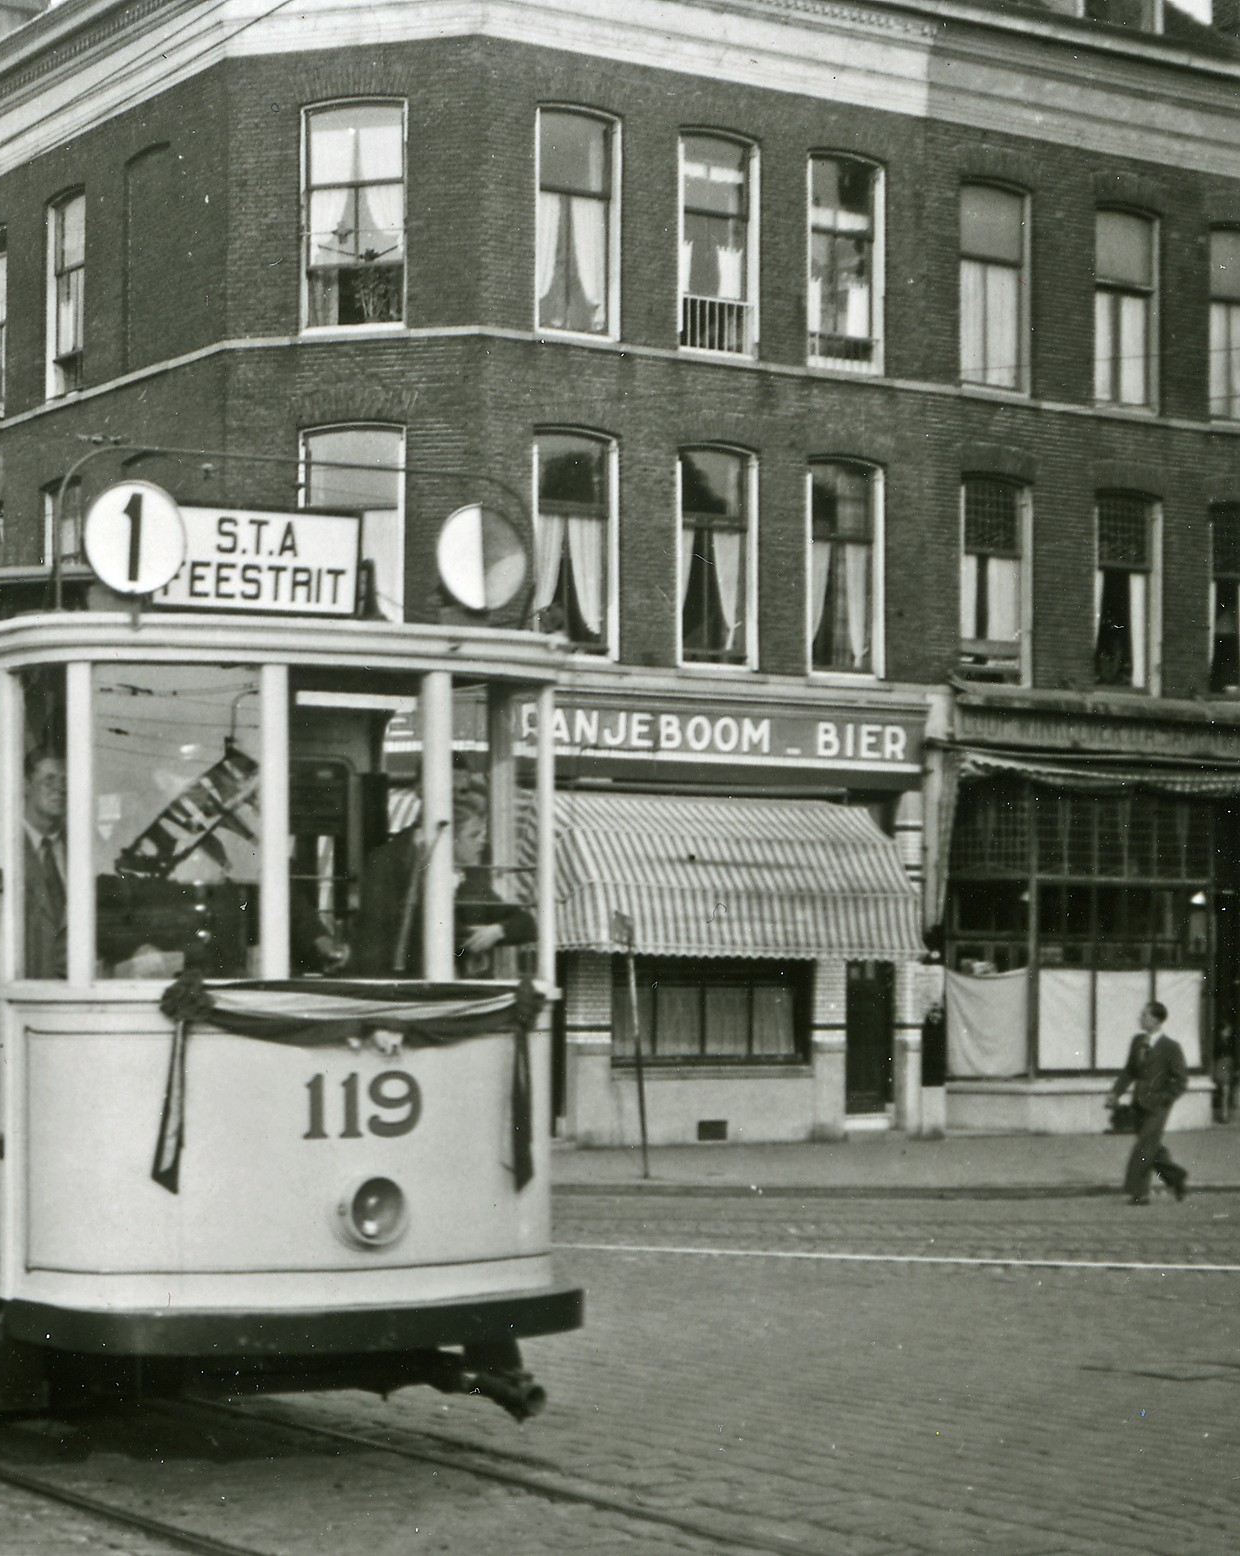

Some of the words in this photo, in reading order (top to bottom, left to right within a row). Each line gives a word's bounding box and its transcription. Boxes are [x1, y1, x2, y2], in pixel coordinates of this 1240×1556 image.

[123, 492, 143, 582] 1
[816, 722, 907, 760] BIER
[302, 1069, 423, 1140] 119
